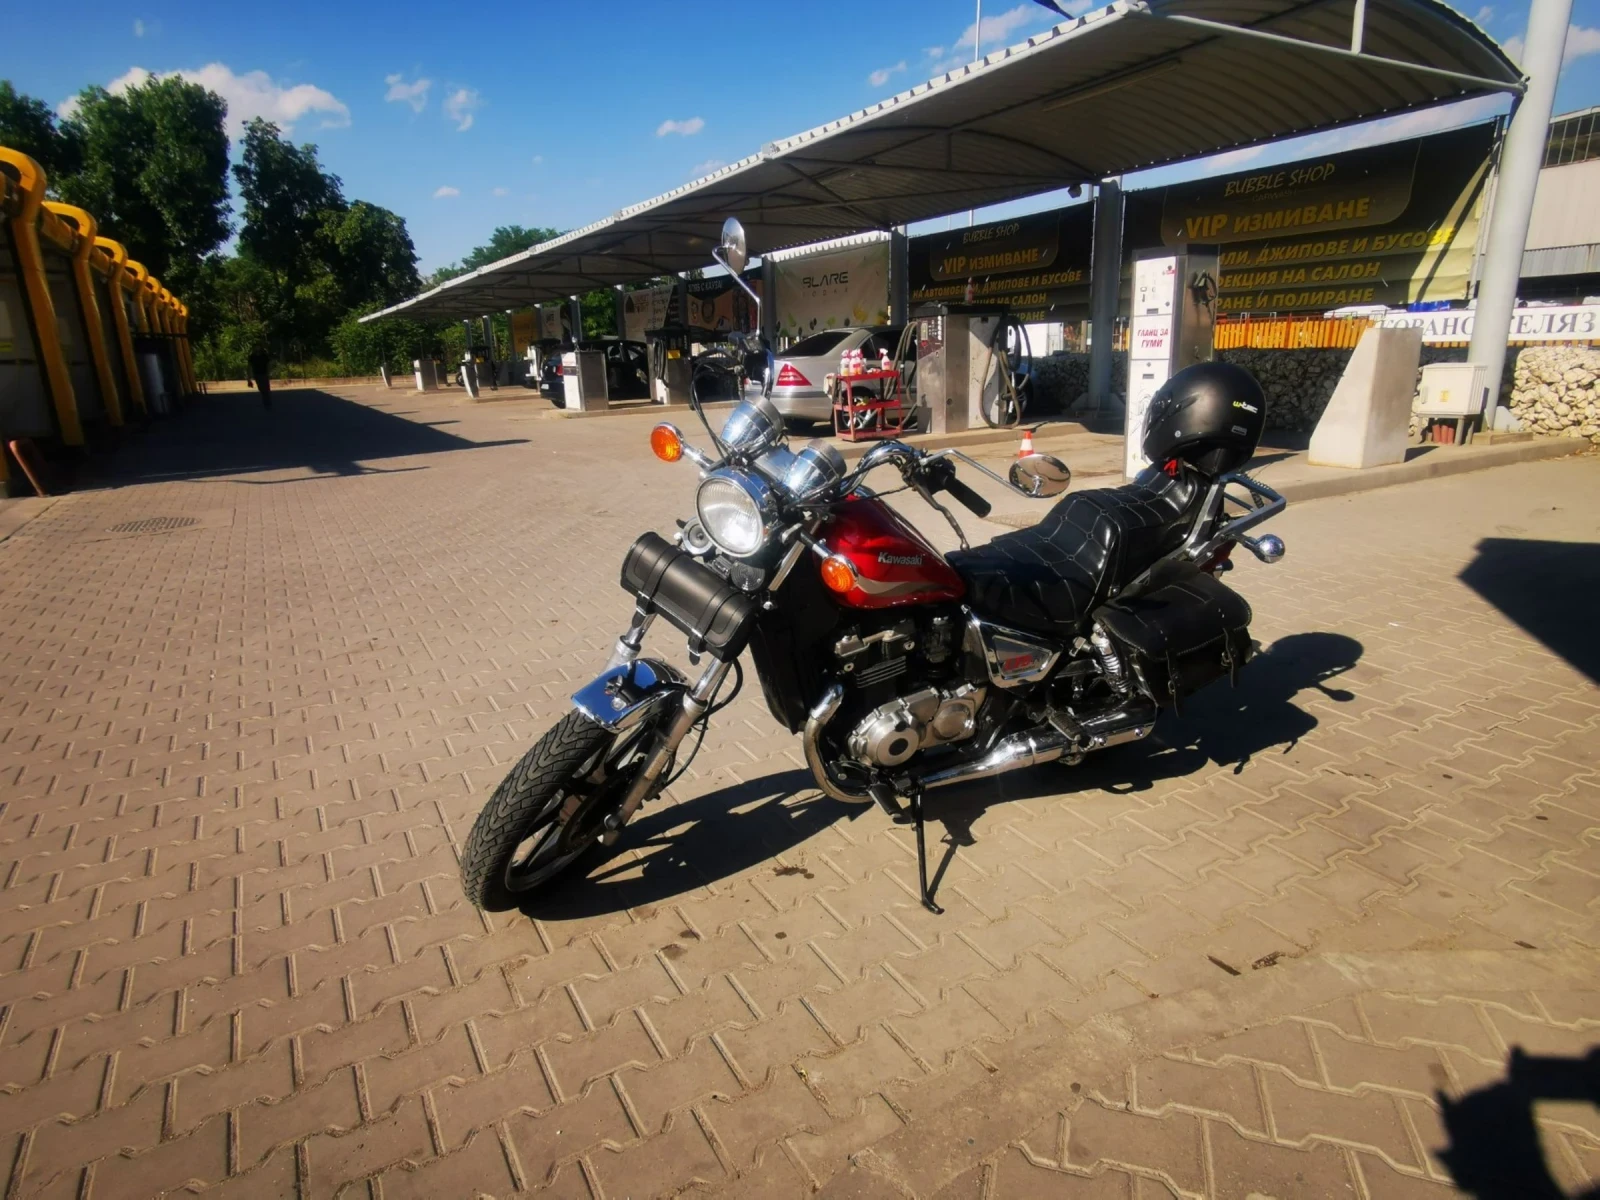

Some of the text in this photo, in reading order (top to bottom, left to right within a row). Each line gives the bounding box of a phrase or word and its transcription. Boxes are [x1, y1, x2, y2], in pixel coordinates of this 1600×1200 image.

[1224, 162, 1335, 197] BUBBLE SHOP
[1185, 197, 1370, 240] VIP ИЗМИВАНЕ
[963, 223, 1020, 244] BUBBLE SHOP
[1256, 240, 1348, 265] ДЖИПОВЕ
[1352, 238, 1366, 253] И
[1372, 227, 1455, 252] БУСОВЕ
[944, 248, 1039, 275] VIP ИЗМИВАНЕ
[1281, 267, 1306, 284] НА
[1312, 261, 1380, 282] САЛОН
[982, 276, 1030, 293] ДЖИПОВЕ
[1031, 273, 1041, 285] И
[1041, 270, 1083, 285] БУСОВЕ
[1012, 292, 1048, 306] САЛОН
[1256, 293, 1270, 309] И
[1272, 288, 1374, 307] ПОЛИРАНЕ
[1160, 328, 1169, 337] ЗА
[1511, 311, 1598, 335] ЕЛЯЗ
[1141, 339, 1163, 349] ГУМИ
[877, 552, 923, 566] Kawasaki
